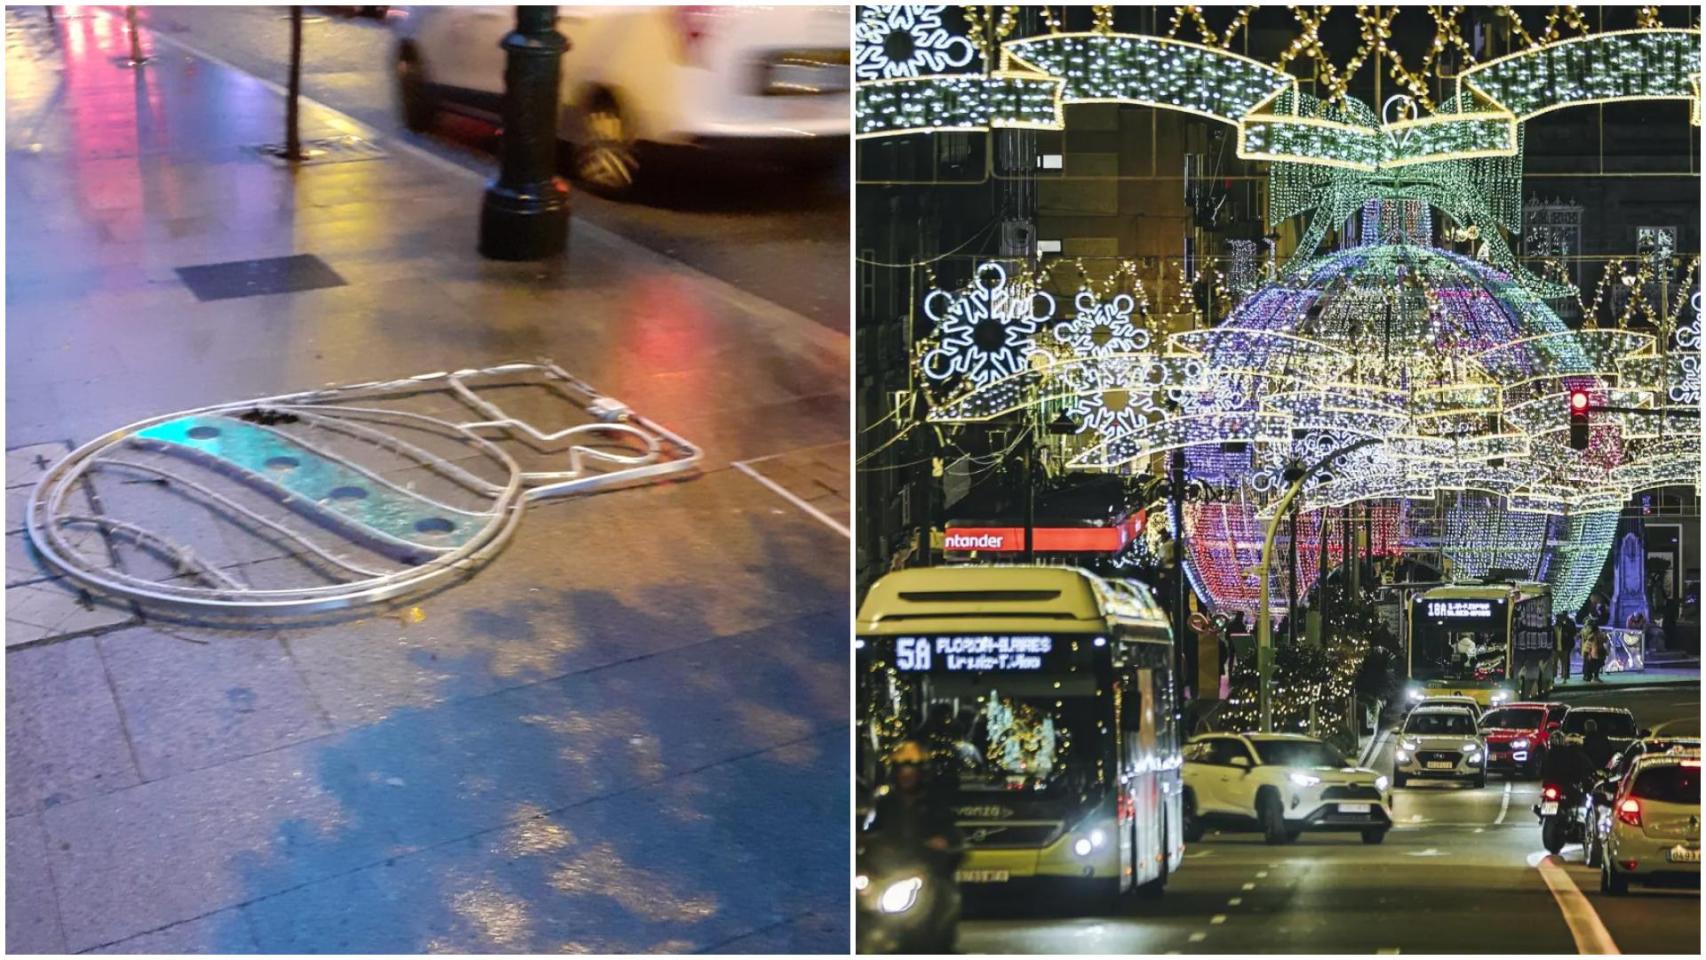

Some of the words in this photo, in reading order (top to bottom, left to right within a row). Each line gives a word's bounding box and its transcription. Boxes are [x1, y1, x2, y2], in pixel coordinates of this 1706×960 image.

[945, 534, 1003, 548] ntander
[896, 637, 931, 670] 5A
[952, 805, 1000, 817] vanza
